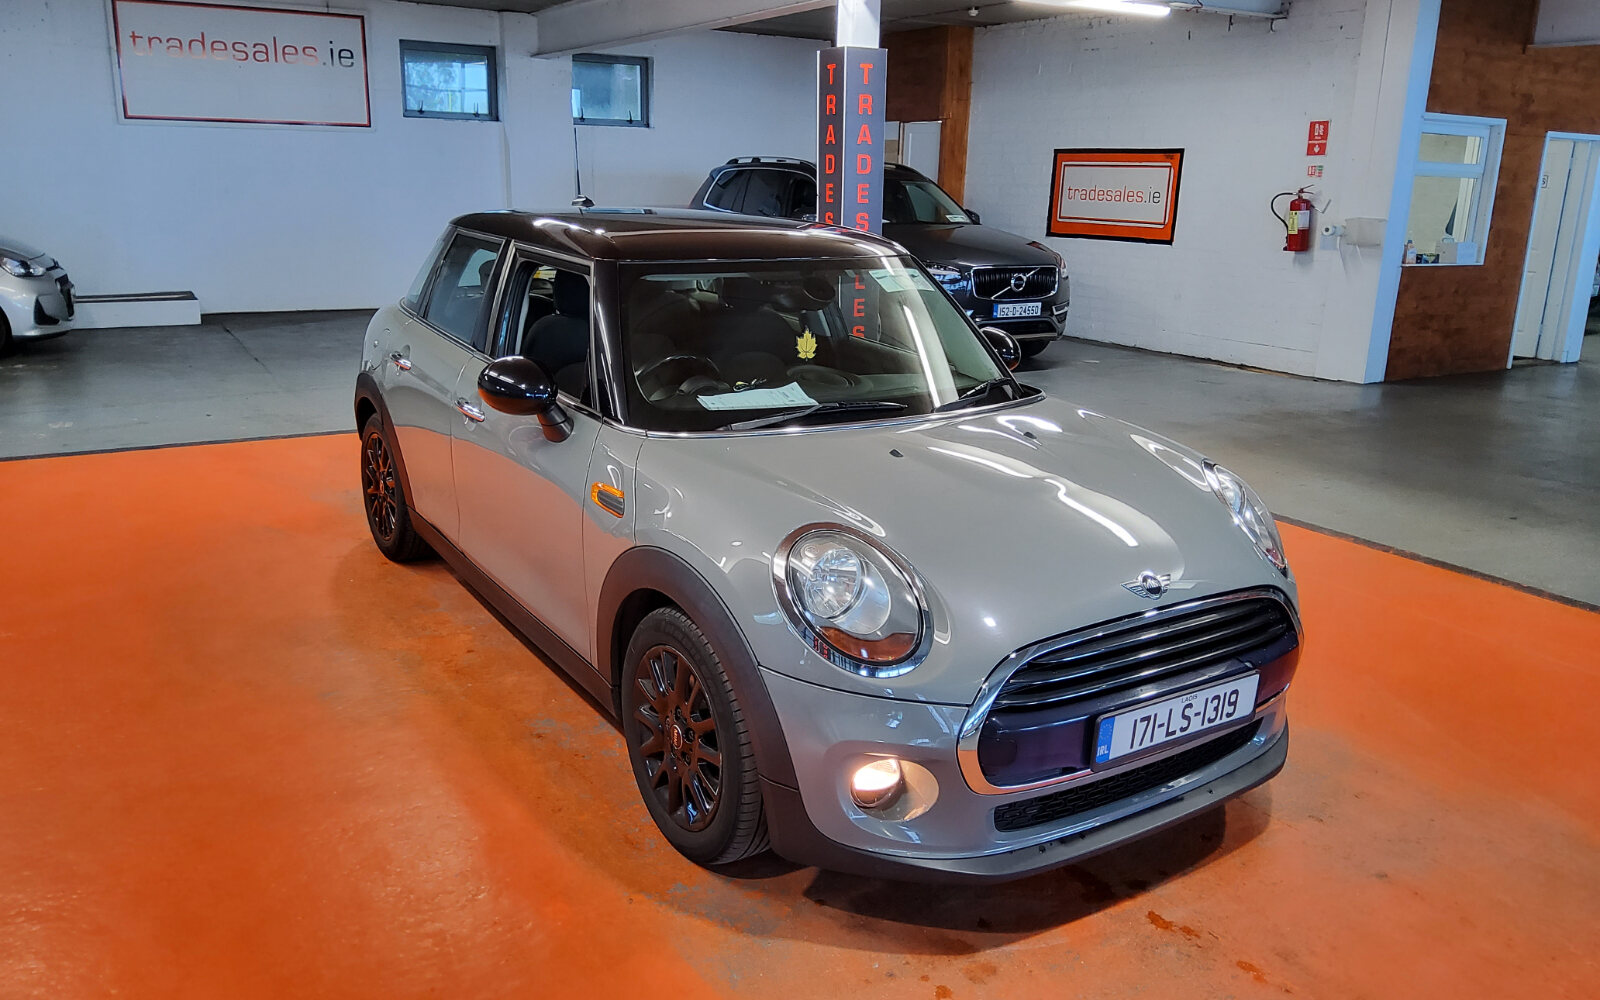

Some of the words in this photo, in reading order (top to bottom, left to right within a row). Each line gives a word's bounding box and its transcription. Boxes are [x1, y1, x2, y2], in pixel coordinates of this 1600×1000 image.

[129, 30, 355, 68] tradesales.ie
[1067, 185, 1161, 204] tradesales.ie
[999, 305, 1039, 317] 152-D-24550
[1129, 688, 1240, 750] 171-LS-1319
[1096, 744, 1109, 757] IRL
